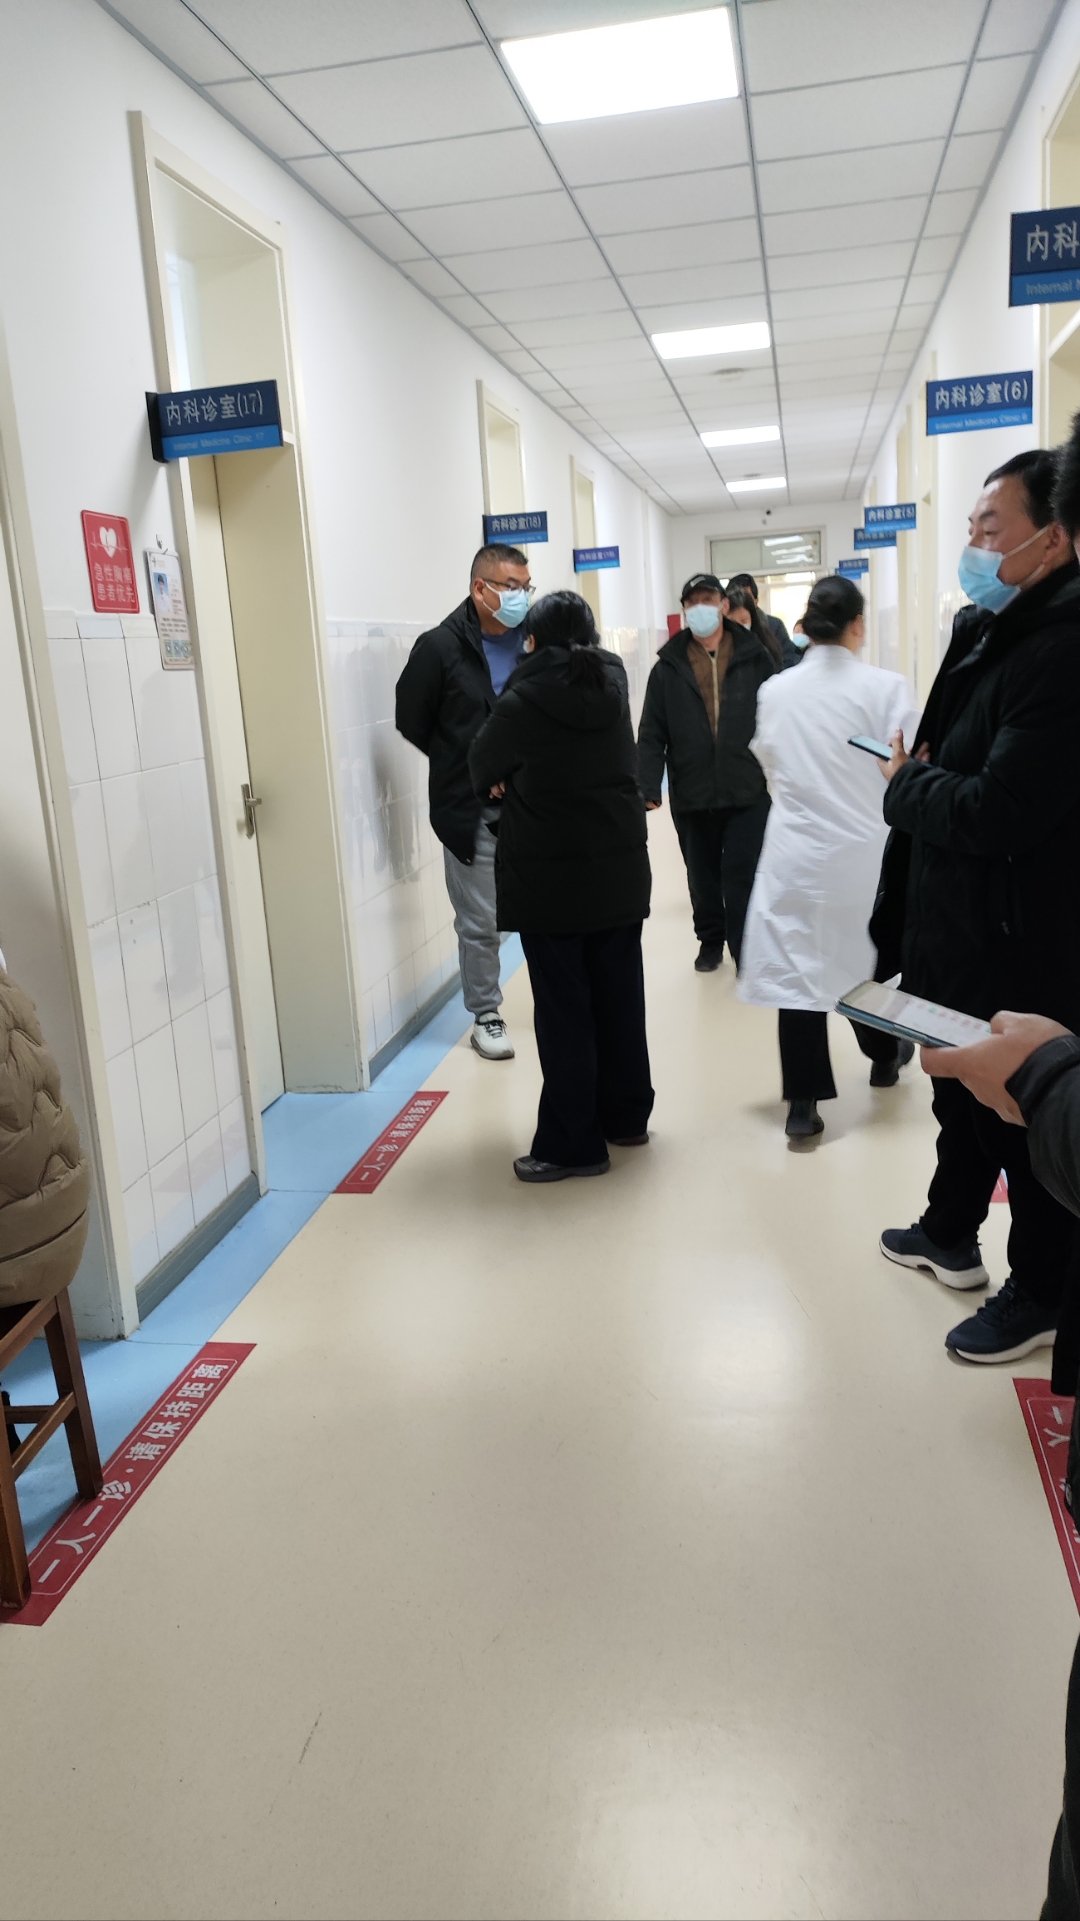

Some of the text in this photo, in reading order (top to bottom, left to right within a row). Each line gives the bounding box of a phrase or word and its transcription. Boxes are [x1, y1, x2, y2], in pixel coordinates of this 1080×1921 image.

[1025, 220, 1080, 262] 内科
[1026, 280, 1073, 296] Internal
[165, 390, 263, 426] 内科诊室(17)
[935, 379, 1028, 411] 内科诊室(6)
